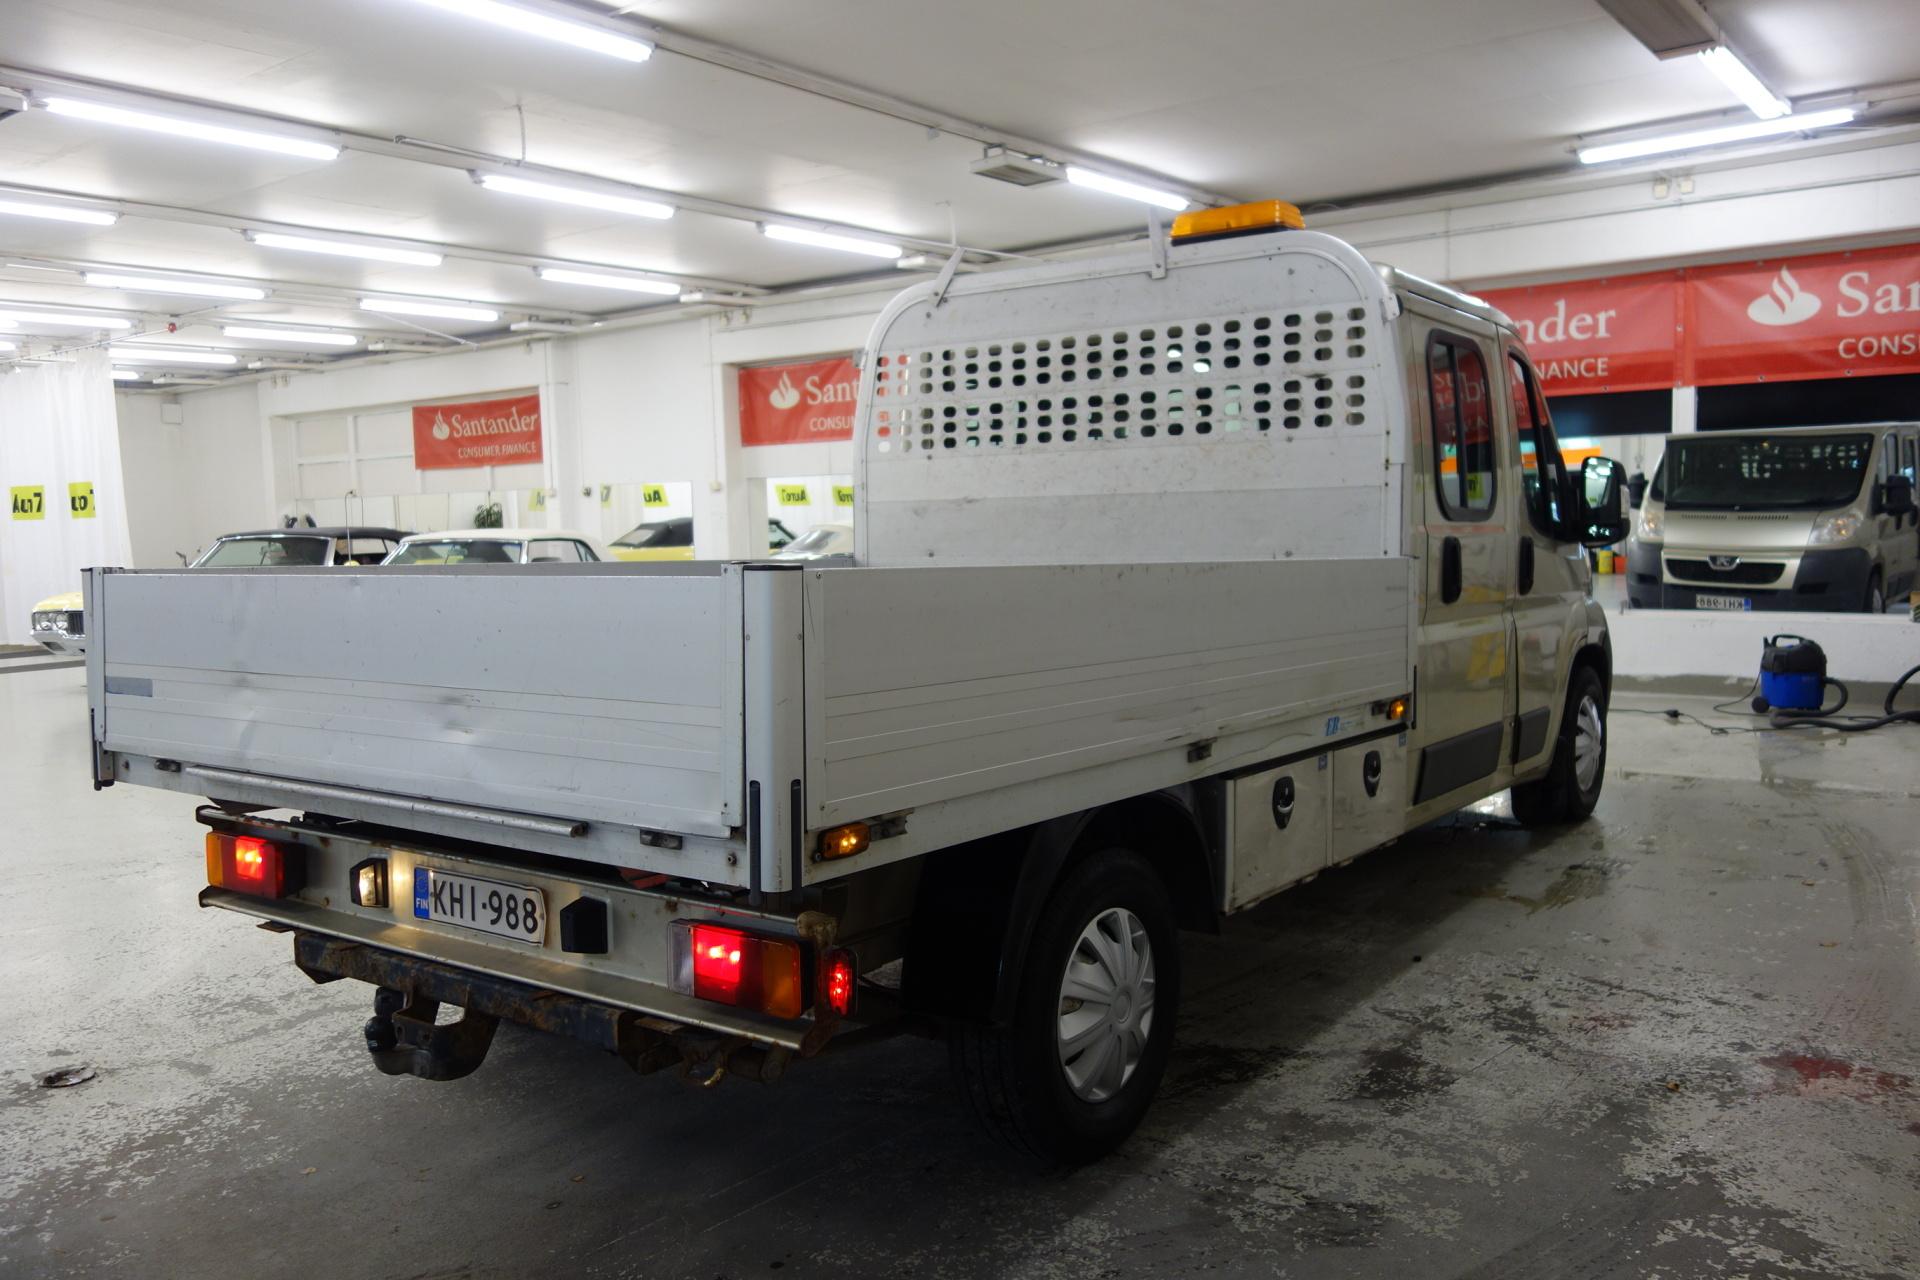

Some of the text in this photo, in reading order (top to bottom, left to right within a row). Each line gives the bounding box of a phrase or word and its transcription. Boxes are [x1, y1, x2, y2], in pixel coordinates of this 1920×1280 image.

[451, 406, 538, 438] Santander
[809, 415, 855, 432] CONSU
[458, 441, 537, 458] CONSUMER FINANCE
[415, 897, 429, 910] FIN
[431, 879, 538, 934] KHI-988
